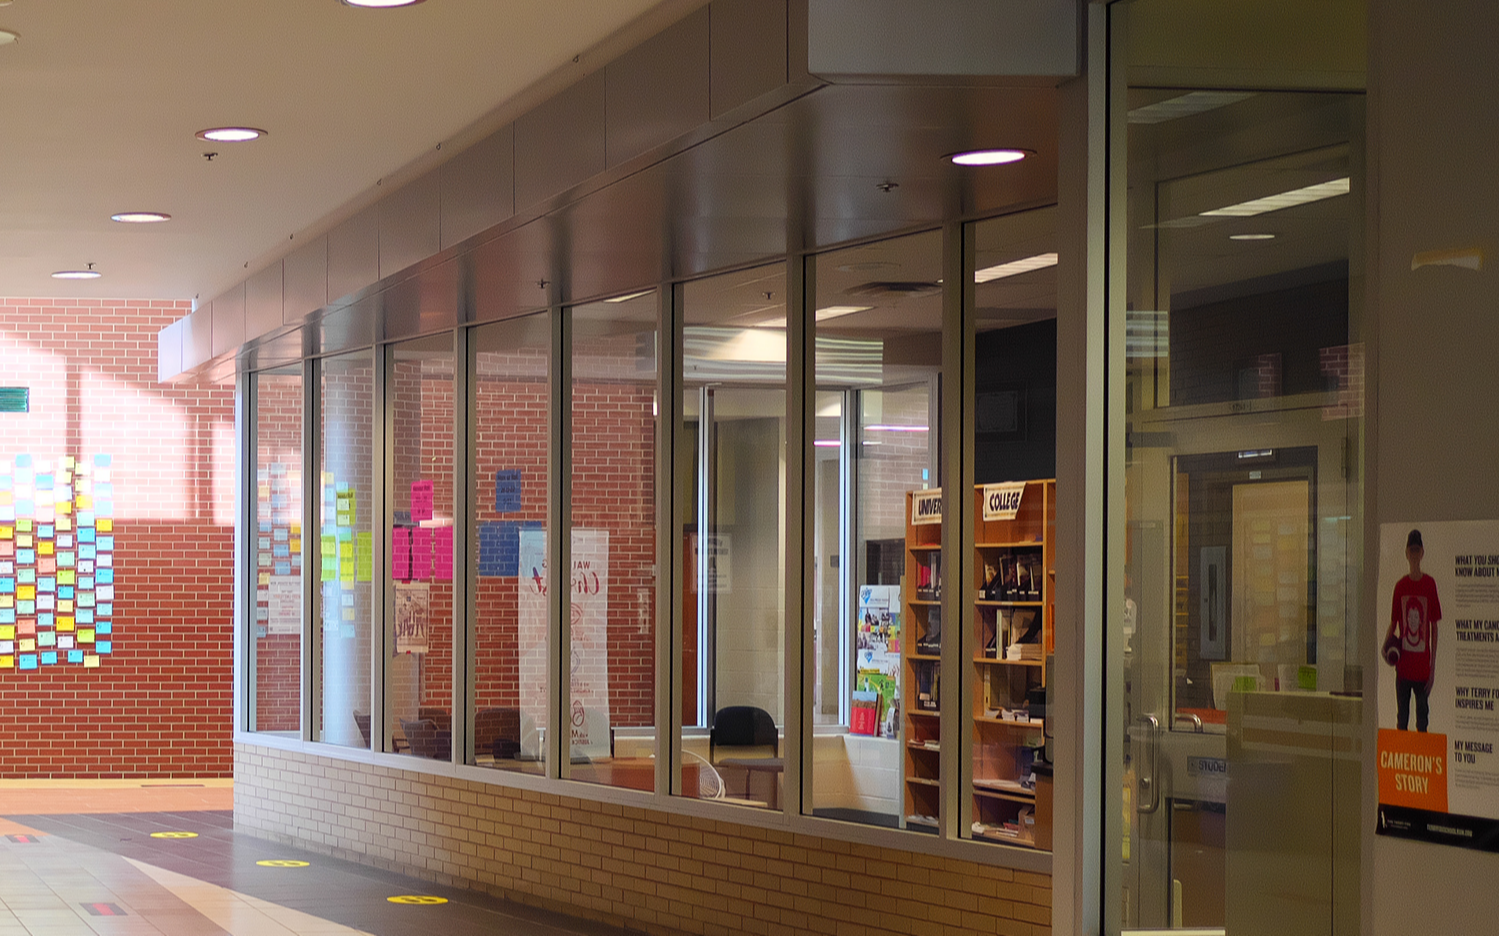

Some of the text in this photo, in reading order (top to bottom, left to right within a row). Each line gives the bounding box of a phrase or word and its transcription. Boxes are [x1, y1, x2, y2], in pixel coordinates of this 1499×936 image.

[989, 491, 1021, 512] COLLEGE
[1454, 554, 1472, 566] WHAT
[1473, 554, 1487, 566] YOU
[1454, 566, 1473, 577] KNOW
[1473, 566, 1495, 577] ABOUT
[1455, 619, 1472, 630] WHAT
[1473, 619, 1483, 630] MY
[1456, 630, 1494, 642] TREATMENTS
[1455, 686, 1470, 697] WHY
[1470, 686, 1491, 699] TERRY
[1455, 698, 1494, 711] INSPIRES ME
[1454, 739, 1493, 754] MY MESSAGE
[1380, 750, 1443, 775] CAMERON'S
[1454, 751, 1476, 764] TO YOU
[1395, 772, 1429, 795] STORY
